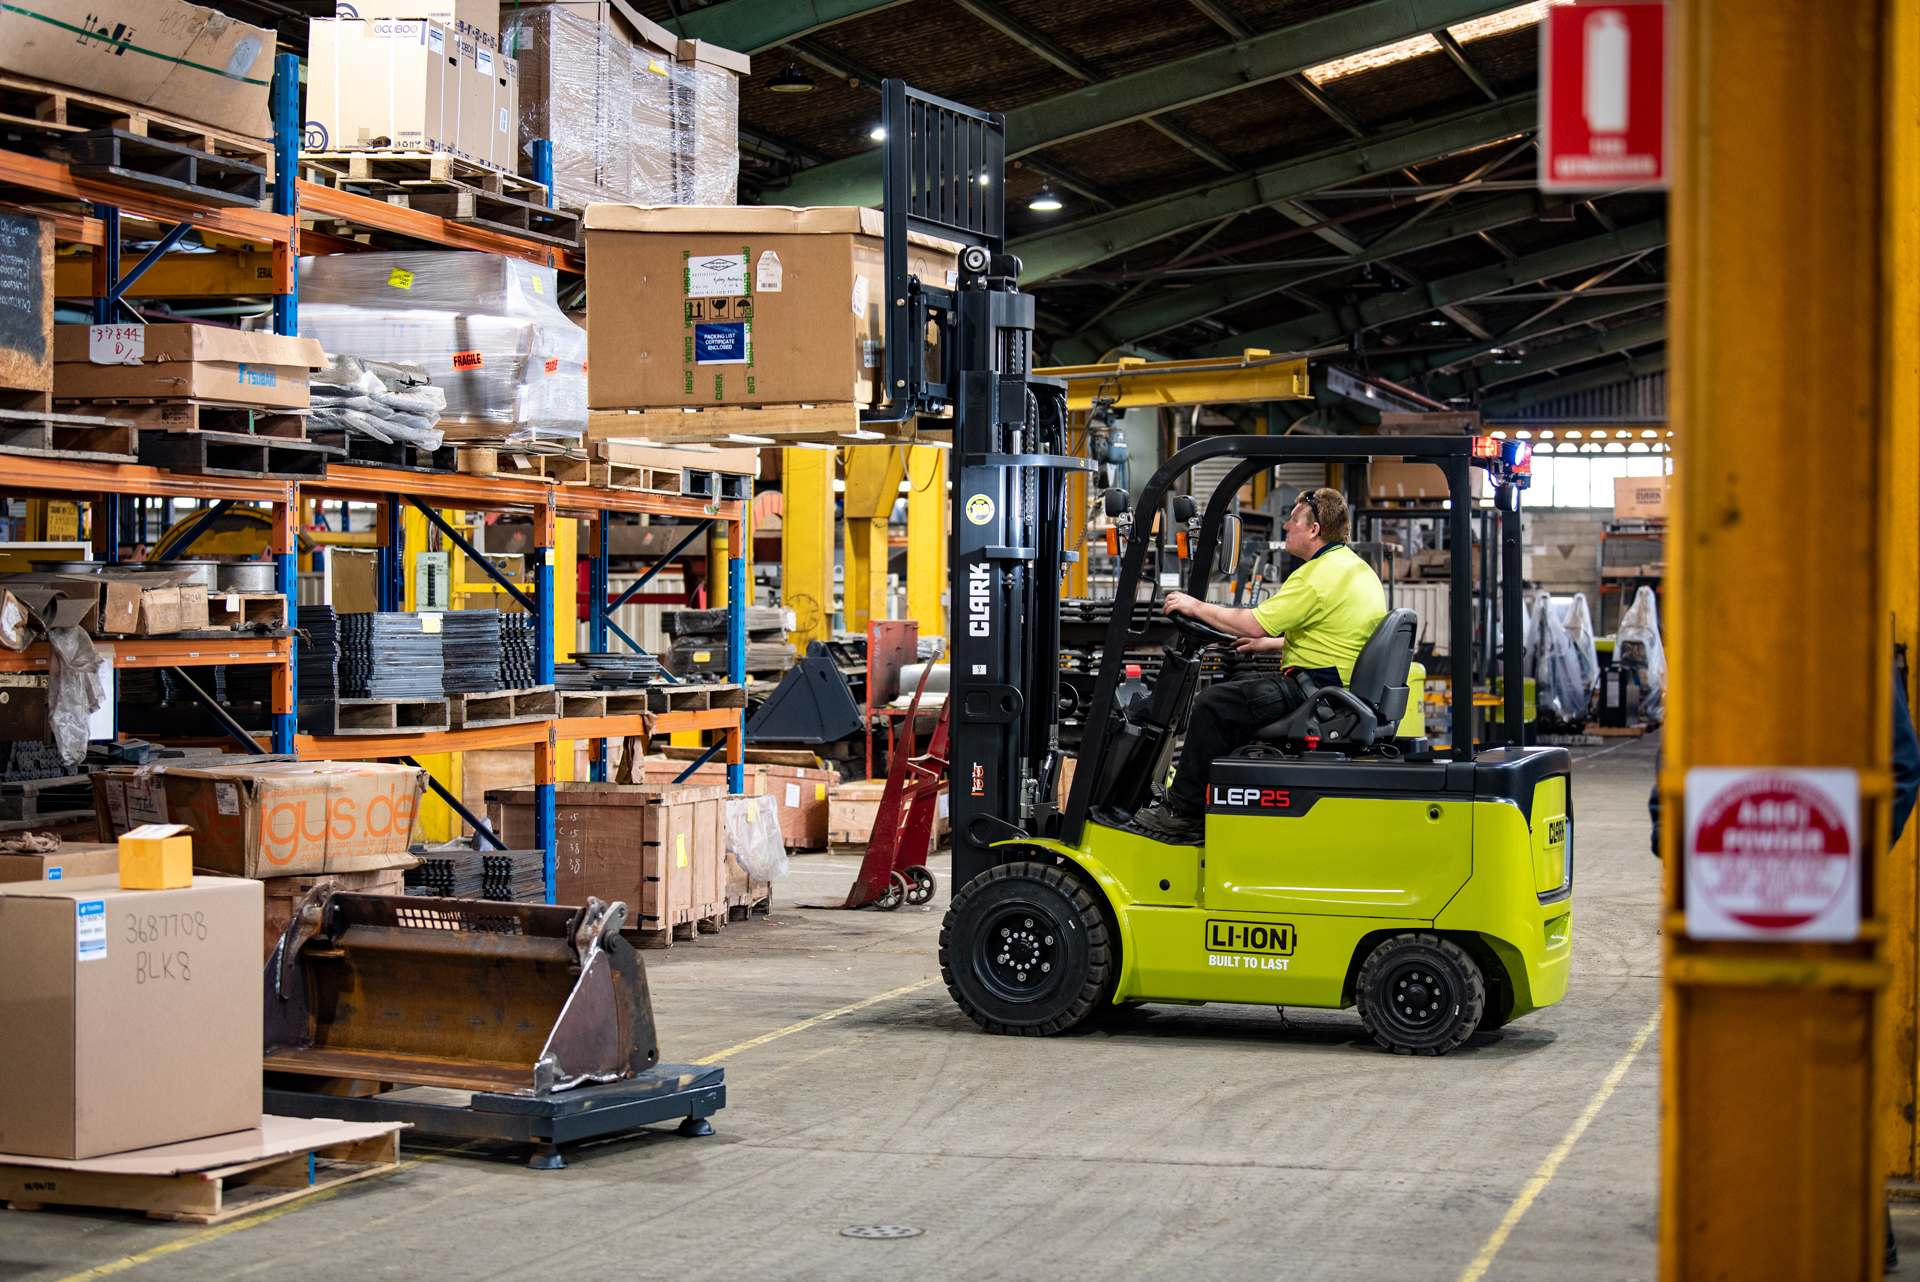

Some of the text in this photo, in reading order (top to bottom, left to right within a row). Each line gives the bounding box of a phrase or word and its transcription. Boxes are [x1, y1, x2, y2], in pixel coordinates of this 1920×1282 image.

[683, 267, 691, 294] CLARK
[97, 327, 141, 342] 37844
[453, 353, 482, 367] FRAGILE
[684, 336, 693, 363] CLARK
[545, 359, 558, 373] FRAGILE
[715, 373, 723, 400] CLARK
[969, 562, 990, 637] CLARK
[271, 788, 300, 799] plastics
[301, 787, 312, 795] for
[1549, 819, 1565, 845] CLARK
[570, 843, 580, 854] 38
[569, 858, 580, 874] 38
[125, 911, 208, 944] 3687708
[1212, 925, 1287, 950] LI-ION
[1208, 954, 1290, 971] BUILT TO LAST
